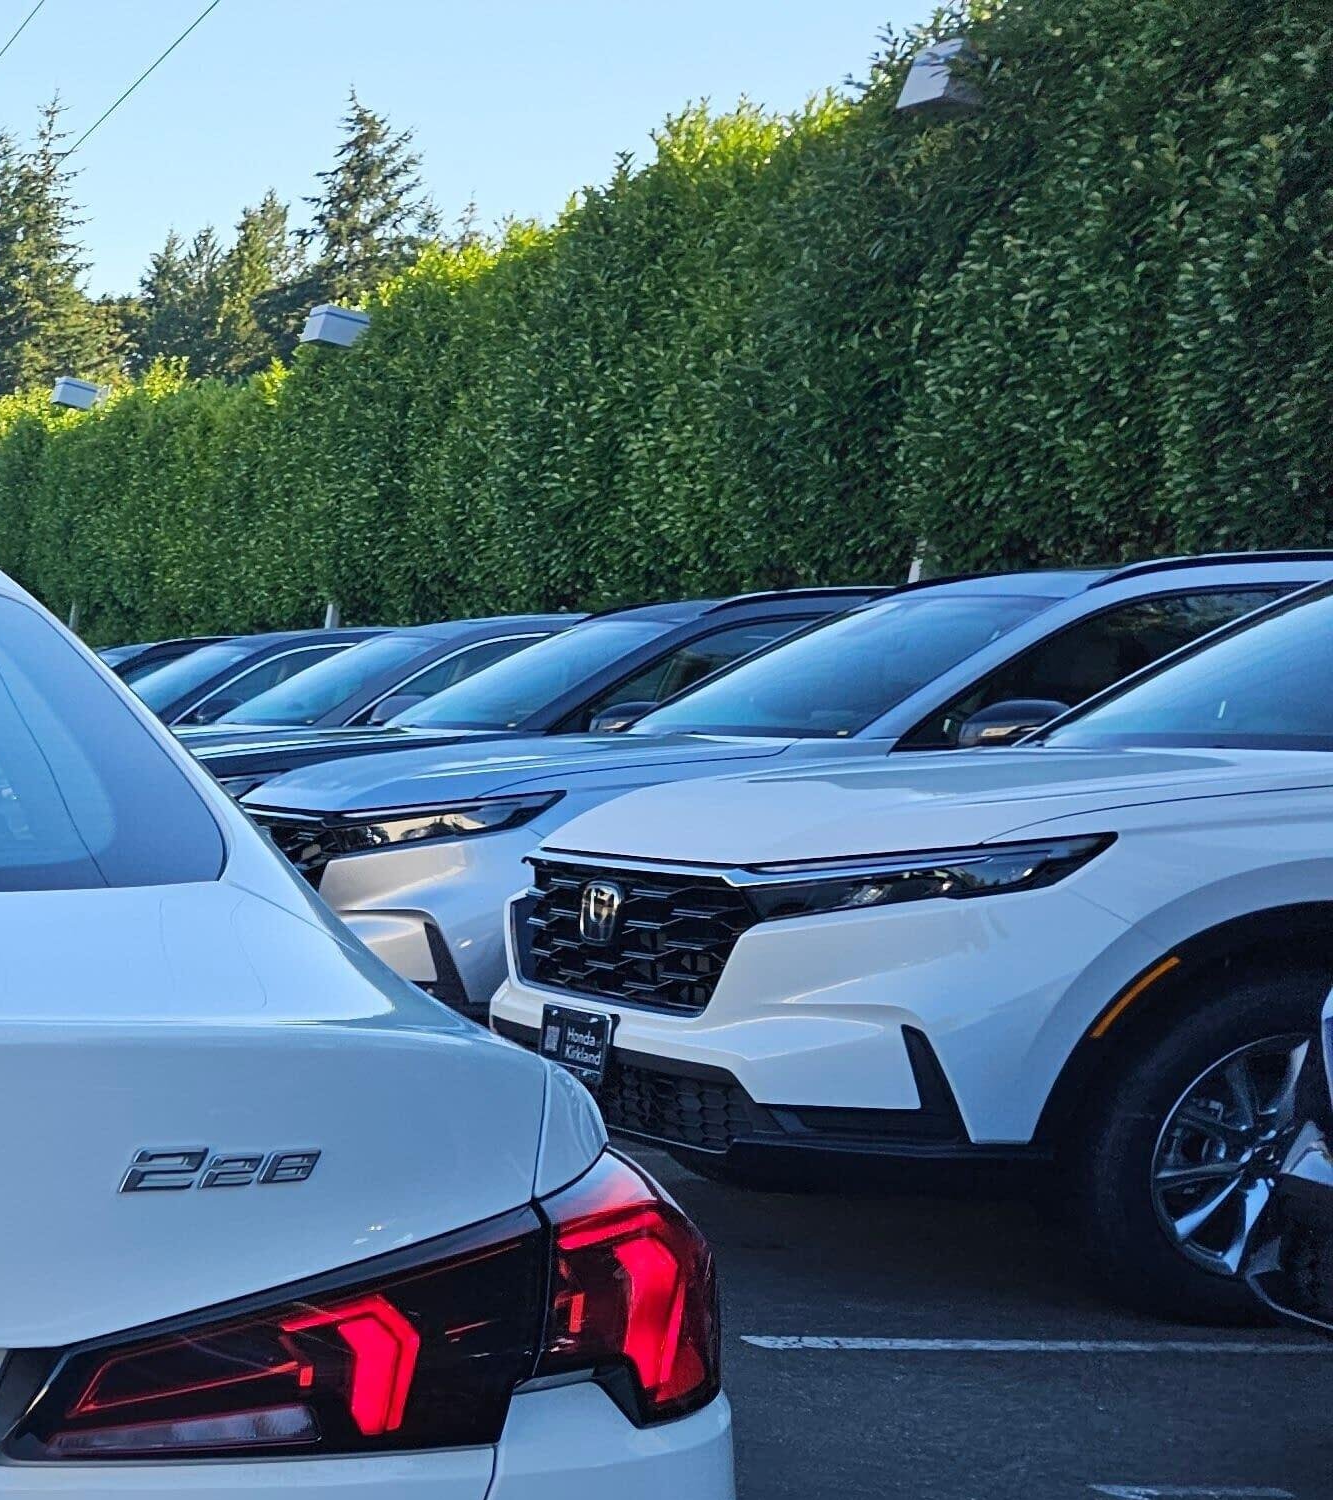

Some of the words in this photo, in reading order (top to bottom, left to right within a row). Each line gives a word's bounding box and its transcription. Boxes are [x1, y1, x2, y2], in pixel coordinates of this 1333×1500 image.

[567, 1026, 596, 1047] Honda
[564, 1043, 602, 1066] Kirkland
[118, 1147, 322, 1194] 228
